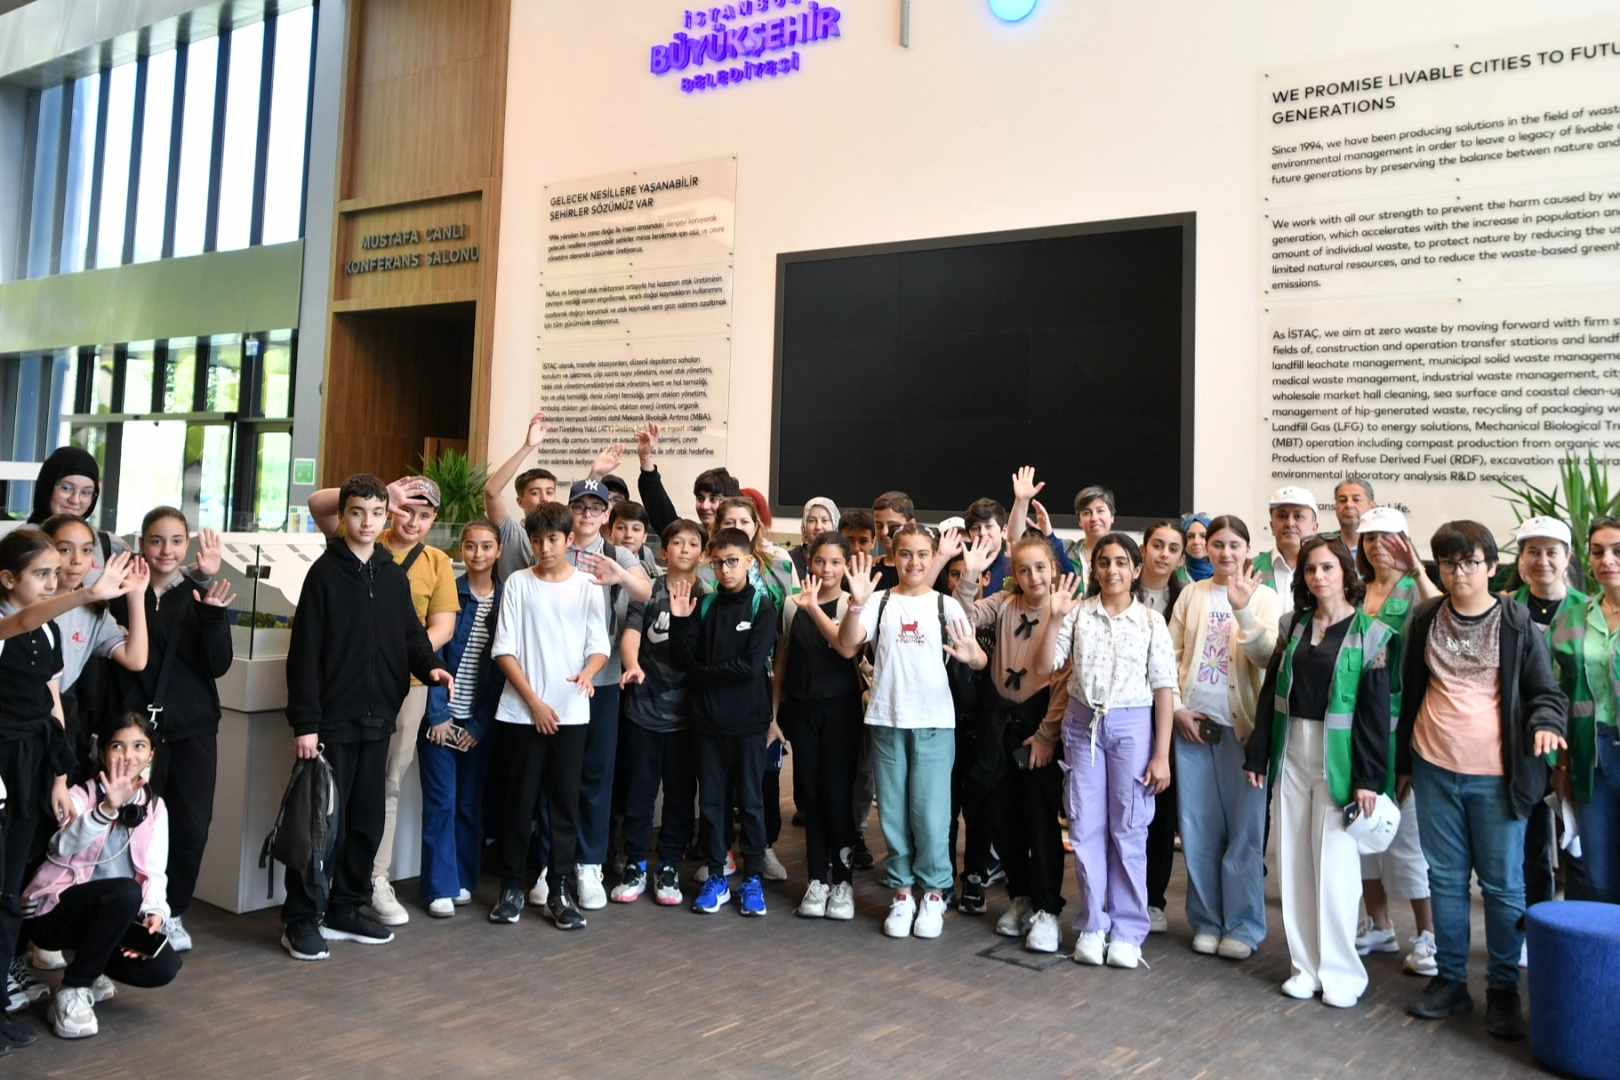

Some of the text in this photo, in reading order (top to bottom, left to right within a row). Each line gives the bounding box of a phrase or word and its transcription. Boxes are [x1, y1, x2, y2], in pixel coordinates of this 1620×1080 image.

[650, 1, 841, 75] BÜYÜKŞEHİR
[681, 51, 800, 93] BELEDİYESİ
[1272, 89, 1298, 103] WE
[1305, 76, 1382, 99] PROMISE
[1389, 64, 1463, 87] LIVABLE
[1470, 55, 1531, 75] CITIES
[1538, 50, 1564, 65] TO
[1272, 96, 1395, 124] GENERATIONS
[1272, 146, 1297, 155] Since
[1300, 141, 1323, 151] 1994,
[1344, 137, 1368, 146] have
[1372, 134, 1396, 143] been
[1399, 126, 1452, 141] producing
[1455, 120, 1504, 132] solutions
[1508, 118, 1517, 126] in
[1521, 115, 1540, 125] the
[1544, 110, 1568, 121] field
[1572, 108, 1584, 118] of
[1588, 106, 1620, 116] wast
[1272, 153, 1341, 170] environmental
[1344, 146, 1413, 161] management
[1416, 144, 1425, 152] in
[1428, 140, 1456, 151] order
[1476, 136, 1504, 145] leave
[1519, 131, 1555, 142] legacy
[1559, 126, 1572, 136] of
[1576, 122, 1613, 134] livable
[1272, 175, 1301, 184] future
[1304, 168, 1362, 183] generations
[1366, 165, 1377, 175] by
[1381, 159, 1435, 174] preserving
[1438, 156, 1456, 165] the
[1460, 152, 1503, 163] balance
[1506, 147, 1550, 158] betwen
[1554, 143, 1594, 153] nature
[550, 176, 698, 206] GELECEK NESİLLERE YAŞANABİLİR
[550, 198, 654, 221] ŞEHİRLER SÖZÜMÜZ VAR
[1272, 220, 1289, 229] We
[1292, 217, 1316, 227] work
[1320, 215, 1341, 225] with
[1344, 213, 1355, 223] all
[1378, 208, 1423, 220] strength
[1442, 203, 1483, 216] prevent
[1488, 200, 1506, 210] the
[1509, 199, 1540, 208] harm
[1543, 193, 1585, 205] caused
[1589, 192, 1603, 202] by
[362, 223, 467, 250] MUSTAFA CANLI
[1272, 211, 1600, 246] generation, which accelerates with the increase in population
[1272, 226, 1605, 259] amount of individual waste, to protect nature by reducing the
[344, 245, 480, 274] KONFERANS SALONU
[1272, 244, 1577, 274] limited natural resources, and to reduce the waste-based
[1272, 279, 1321, 289] emissions.
[1273, 331, 1285, 340] As
[1288, 328, 1321, 340] İSTAÇ,
[1342, 328, 1361, 337] aim
[1364, 327, 1376, 336] at
[1404, 325, 1438, 334] waste
[1441, 323, 1454, 334] by
[1458, 322, 1498, 333] moving
[1502, 319, 1549, 330] forward
[1553, 318, 1580, 328] with
[1584, 317, 1609, 326] firm
[1273, 345, 1298, 355] fields
[1301, 344, 1313, 354] of,
[1316, 342, 1379, 353] construction
[1382, 341, 1402, 351] and
[1405, 340, 1457, 352] operation
[1461, 337, 1506, 348] transfer
[1510, 336, 1558, 346] stations
[1562, 335, 1585, 345] and
[1272, 360, 1304, 370] landfill
[1307, 360, 1349, 369] leachate
[1353, 358, 1425, 369] management,
[1429, 355, 1481, 366] municipal
[1484, 354, 1510, 364] solid
[1514, 354, 1550, 363] waste
[1272, 421, 1600, 434] Landfill Gas (LFG) to energy solutions, Mechanical Biological
[1272, 469, 1342, 479] environmental
[1344, 470, 1400, 483] laboratory
[1404, 471, 1447, 483] analysis
[1450, 471, 1476, 481] R&D
